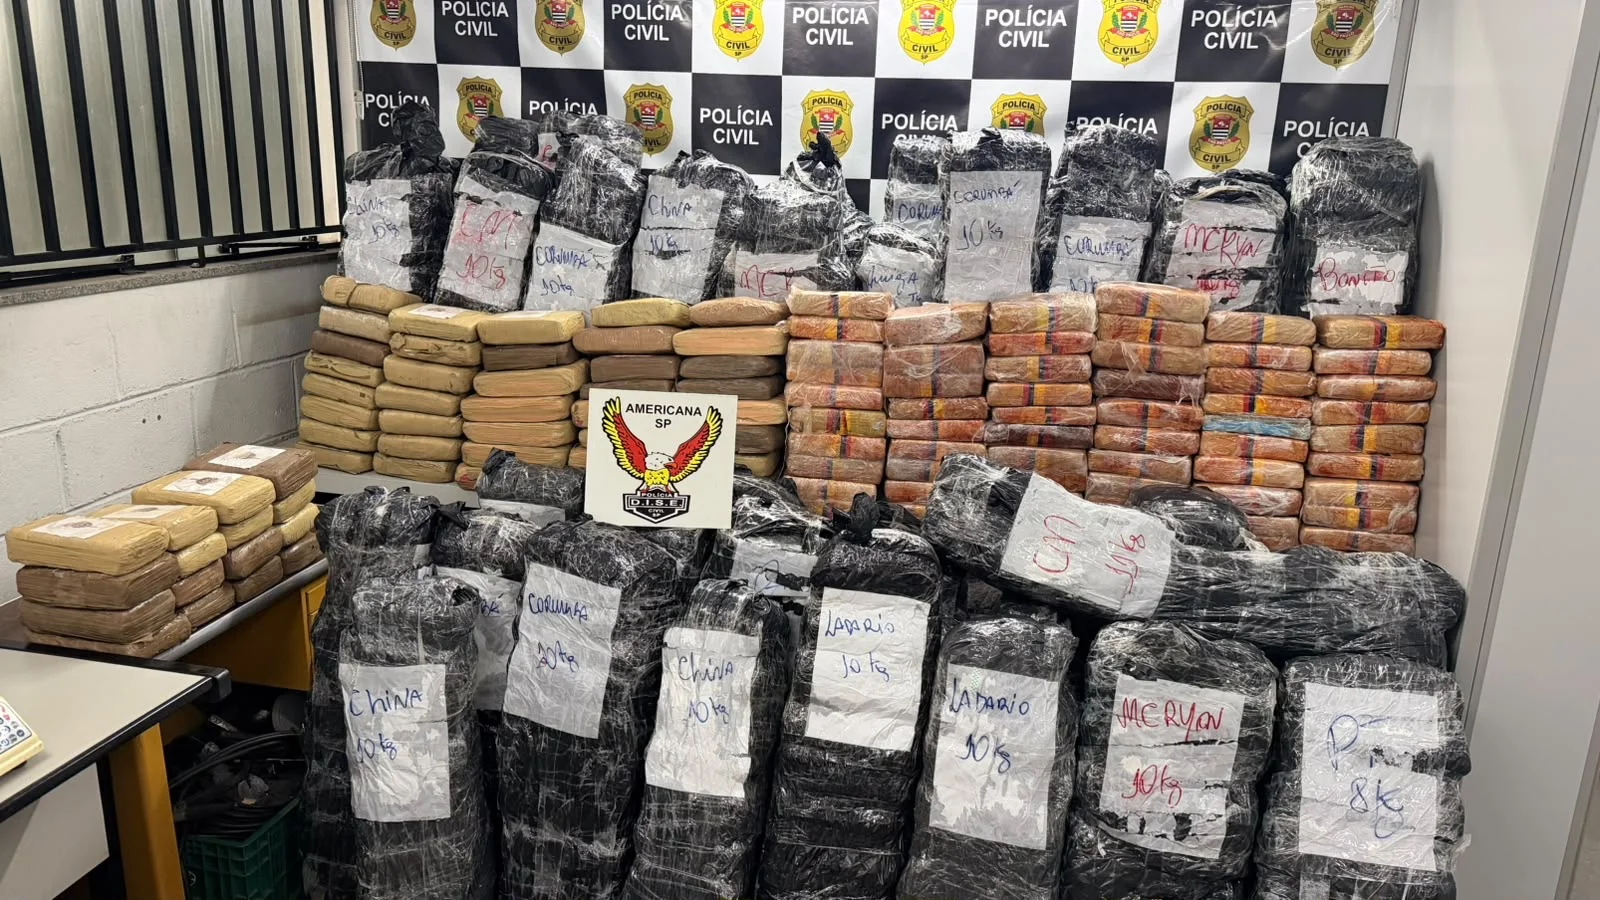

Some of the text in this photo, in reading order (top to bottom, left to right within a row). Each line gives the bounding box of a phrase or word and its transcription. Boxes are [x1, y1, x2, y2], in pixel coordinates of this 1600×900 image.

[611, 0, 684, 21] POLÍCIA
[792, 4, 869, 25] POLÍCIA
[985, 5, 1067, 27] POLÍCIA
[1191, 6, 1278, 28] POLÍCIA
[384, 31, 407, 40] CIVIL
[455, 20, 498, 36] CIVIL
[624, 24, 669, 41] CIVIL
[549, 36, 572, 45] CIVIL
[726, 41, 750, 50] CIVIL
[806, 28, 853, 46] CIVIL
[998, 30, 1049, 48] CIVIL
[1204, 32, 1258, 50] CIVIL
[912, 44, 938, 53] CIVIL
[1112, 46, 1140, 55] CIVIL
[1002, 100, 1036, 111] POLÍCIA
[1206, 103, 1242, 114] POLÍCIA
[700, 105, 773, 127] POLÍCIA
[881, 110, 959, 131] POLÍCIA
[1283, 116, 1370, 138] POLÍCIA
[713, 128, 759, 145] CIVIL
[1203, 153, 1232, 162] CIVIL
[625, 403, 702, 417] AMERICANA
[655, 418, 672, 429] SP
